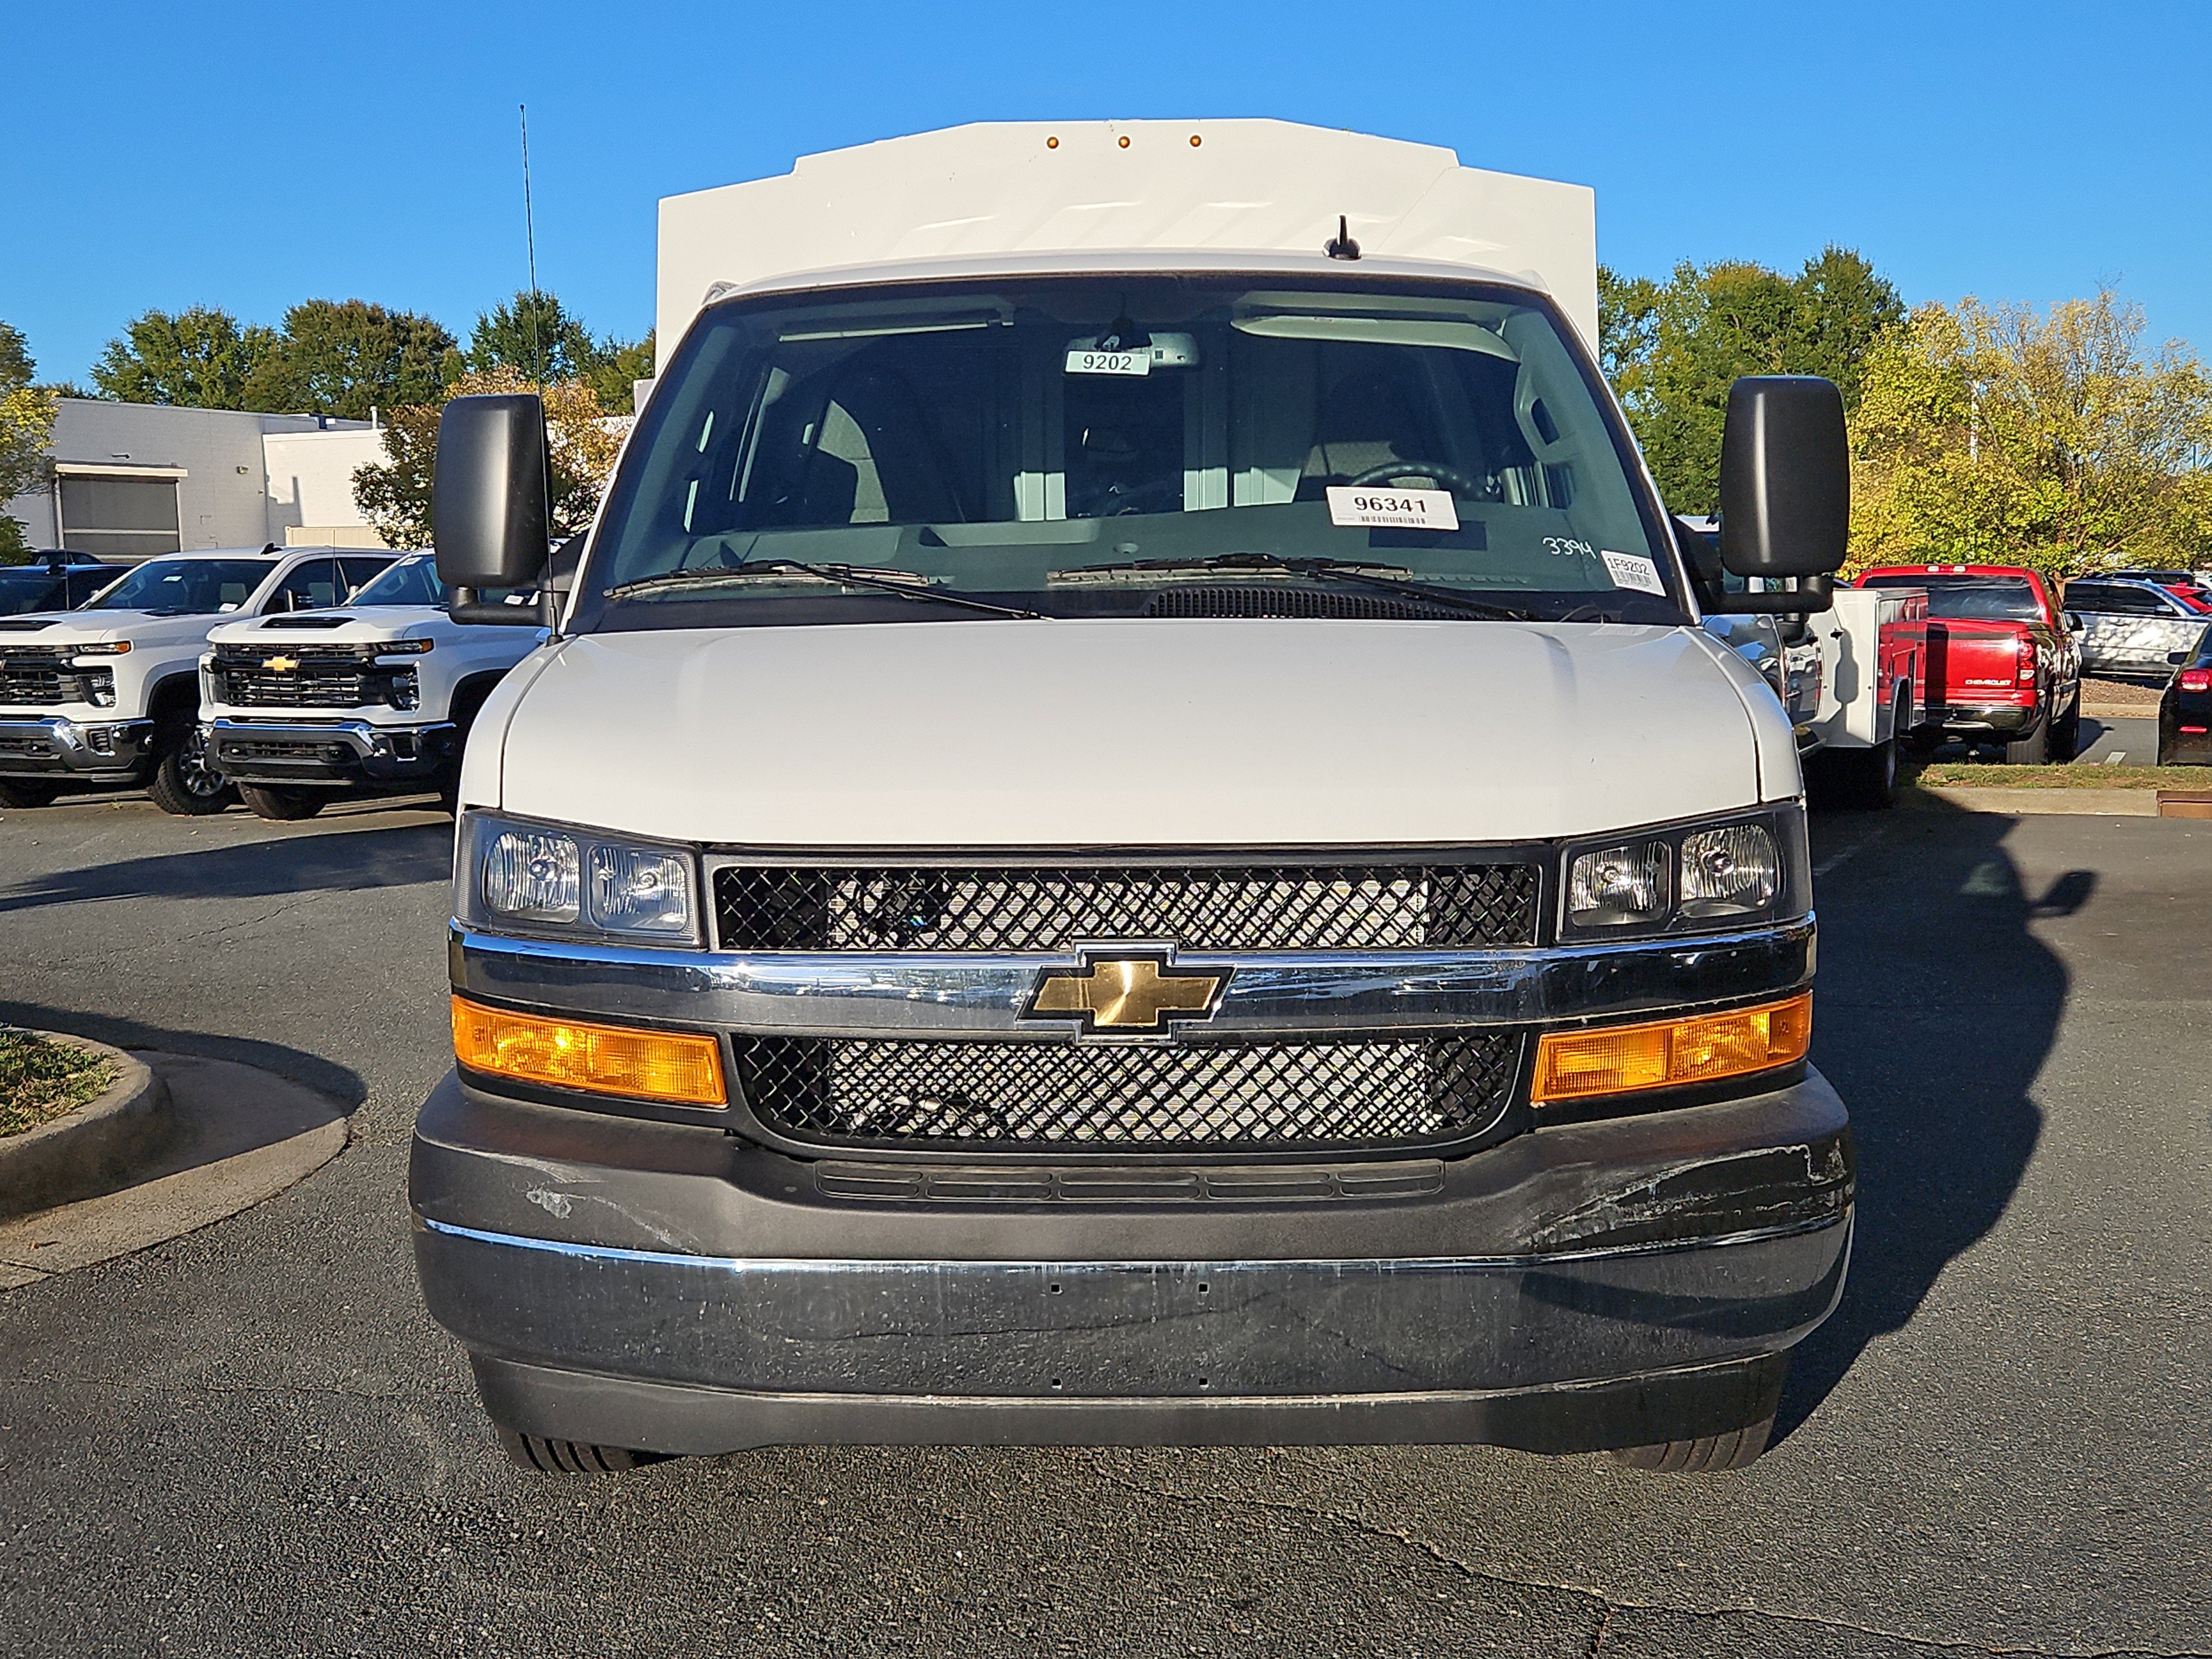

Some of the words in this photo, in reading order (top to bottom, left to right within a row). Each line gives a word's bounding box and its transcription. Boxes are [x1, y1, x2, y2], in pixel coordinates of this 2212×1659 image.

[1083, 355, 1132, 370] 9202
[1354, 497, 1426, 513] 96341
[1543, 537, 1597, 560] 3394
[1607, 557, 1650, 575] 1F9202
